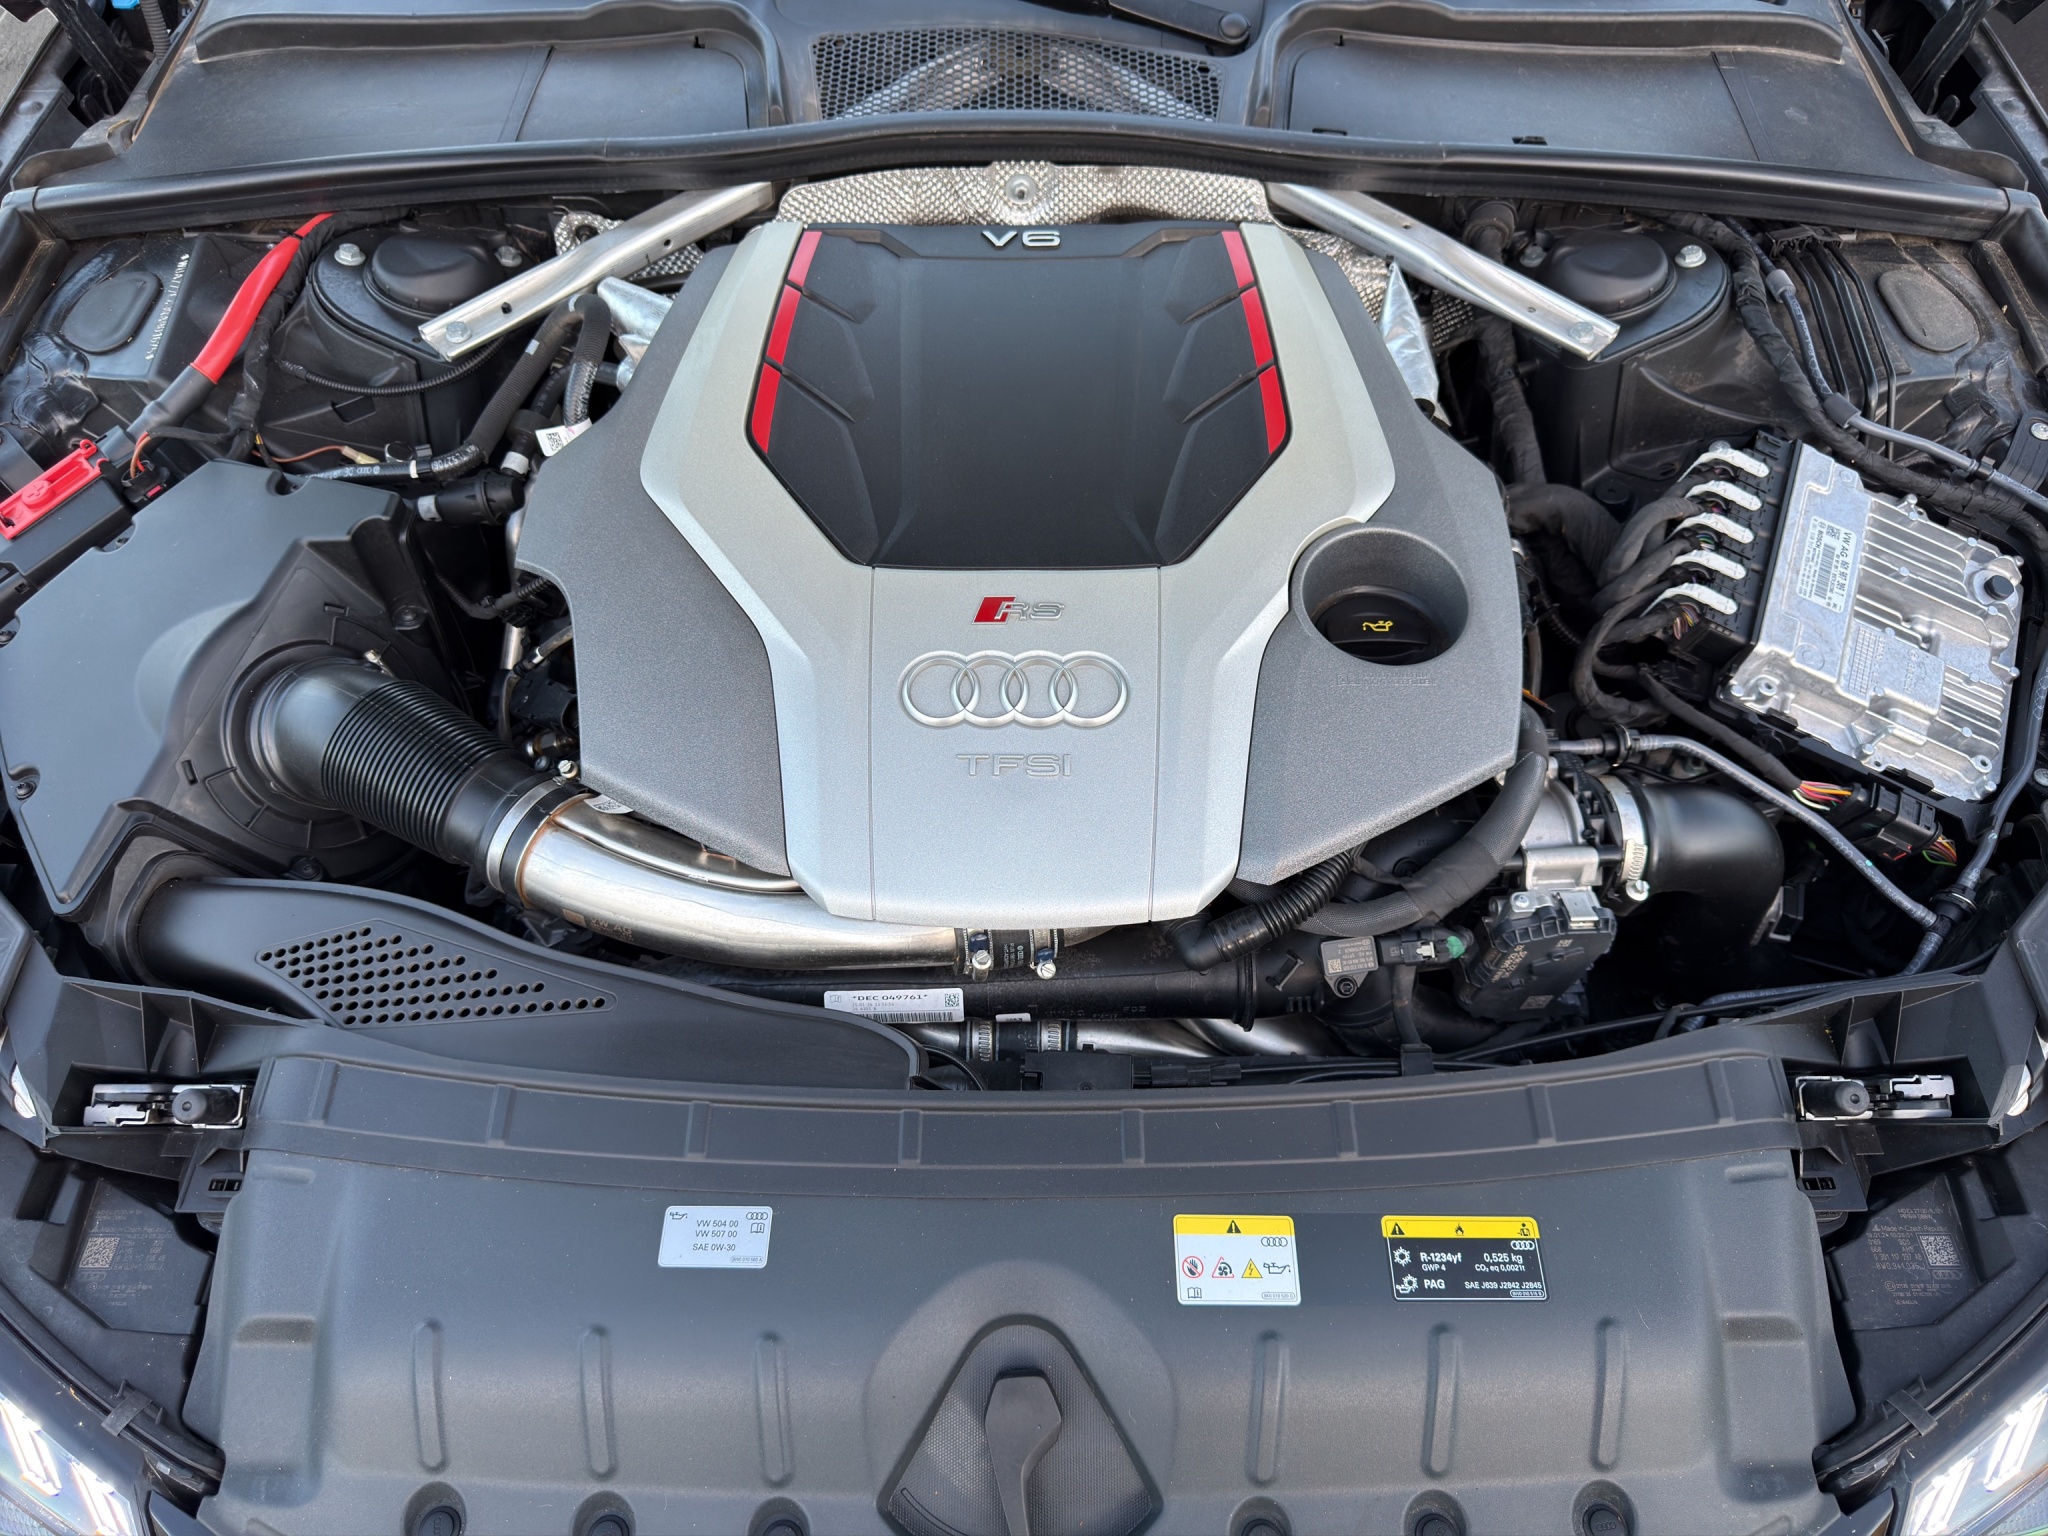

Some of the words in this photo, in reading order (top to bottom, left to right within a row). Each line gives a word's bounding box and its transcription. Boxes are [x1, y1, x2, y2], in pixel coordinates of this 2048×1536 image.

[981, 230, 1061, 250] V6
[1815, 529, 1824, 549] BOSCH
[1842, 532, 1852, 546] VW
[1840, 545, 1848, 558] AG
[993, 602, 1065, 621] RS
[957, 754, 1072, 777] TFSI
[696, 1220, 711, 1228] VW
[712, 1220, 727, 1228] 504
[729, 1220, 739, 1228] 00
[695, 1230, 710, 1238] VW
[711, 1230, 726, 1238] 507
[727, 1230, 738, 1238] 00
[692, 1243, 709, 1251] SAE
[1420, 1252, 1462, 1264] R-1234yf
[1483, 1253, 1509, 1263] 0,525
[1511, 1253, 1523, 1264] kg
[1500, 1264, 1526, 1272] 0,0021t
[1424, 1279, 1445, 1289] PAG
